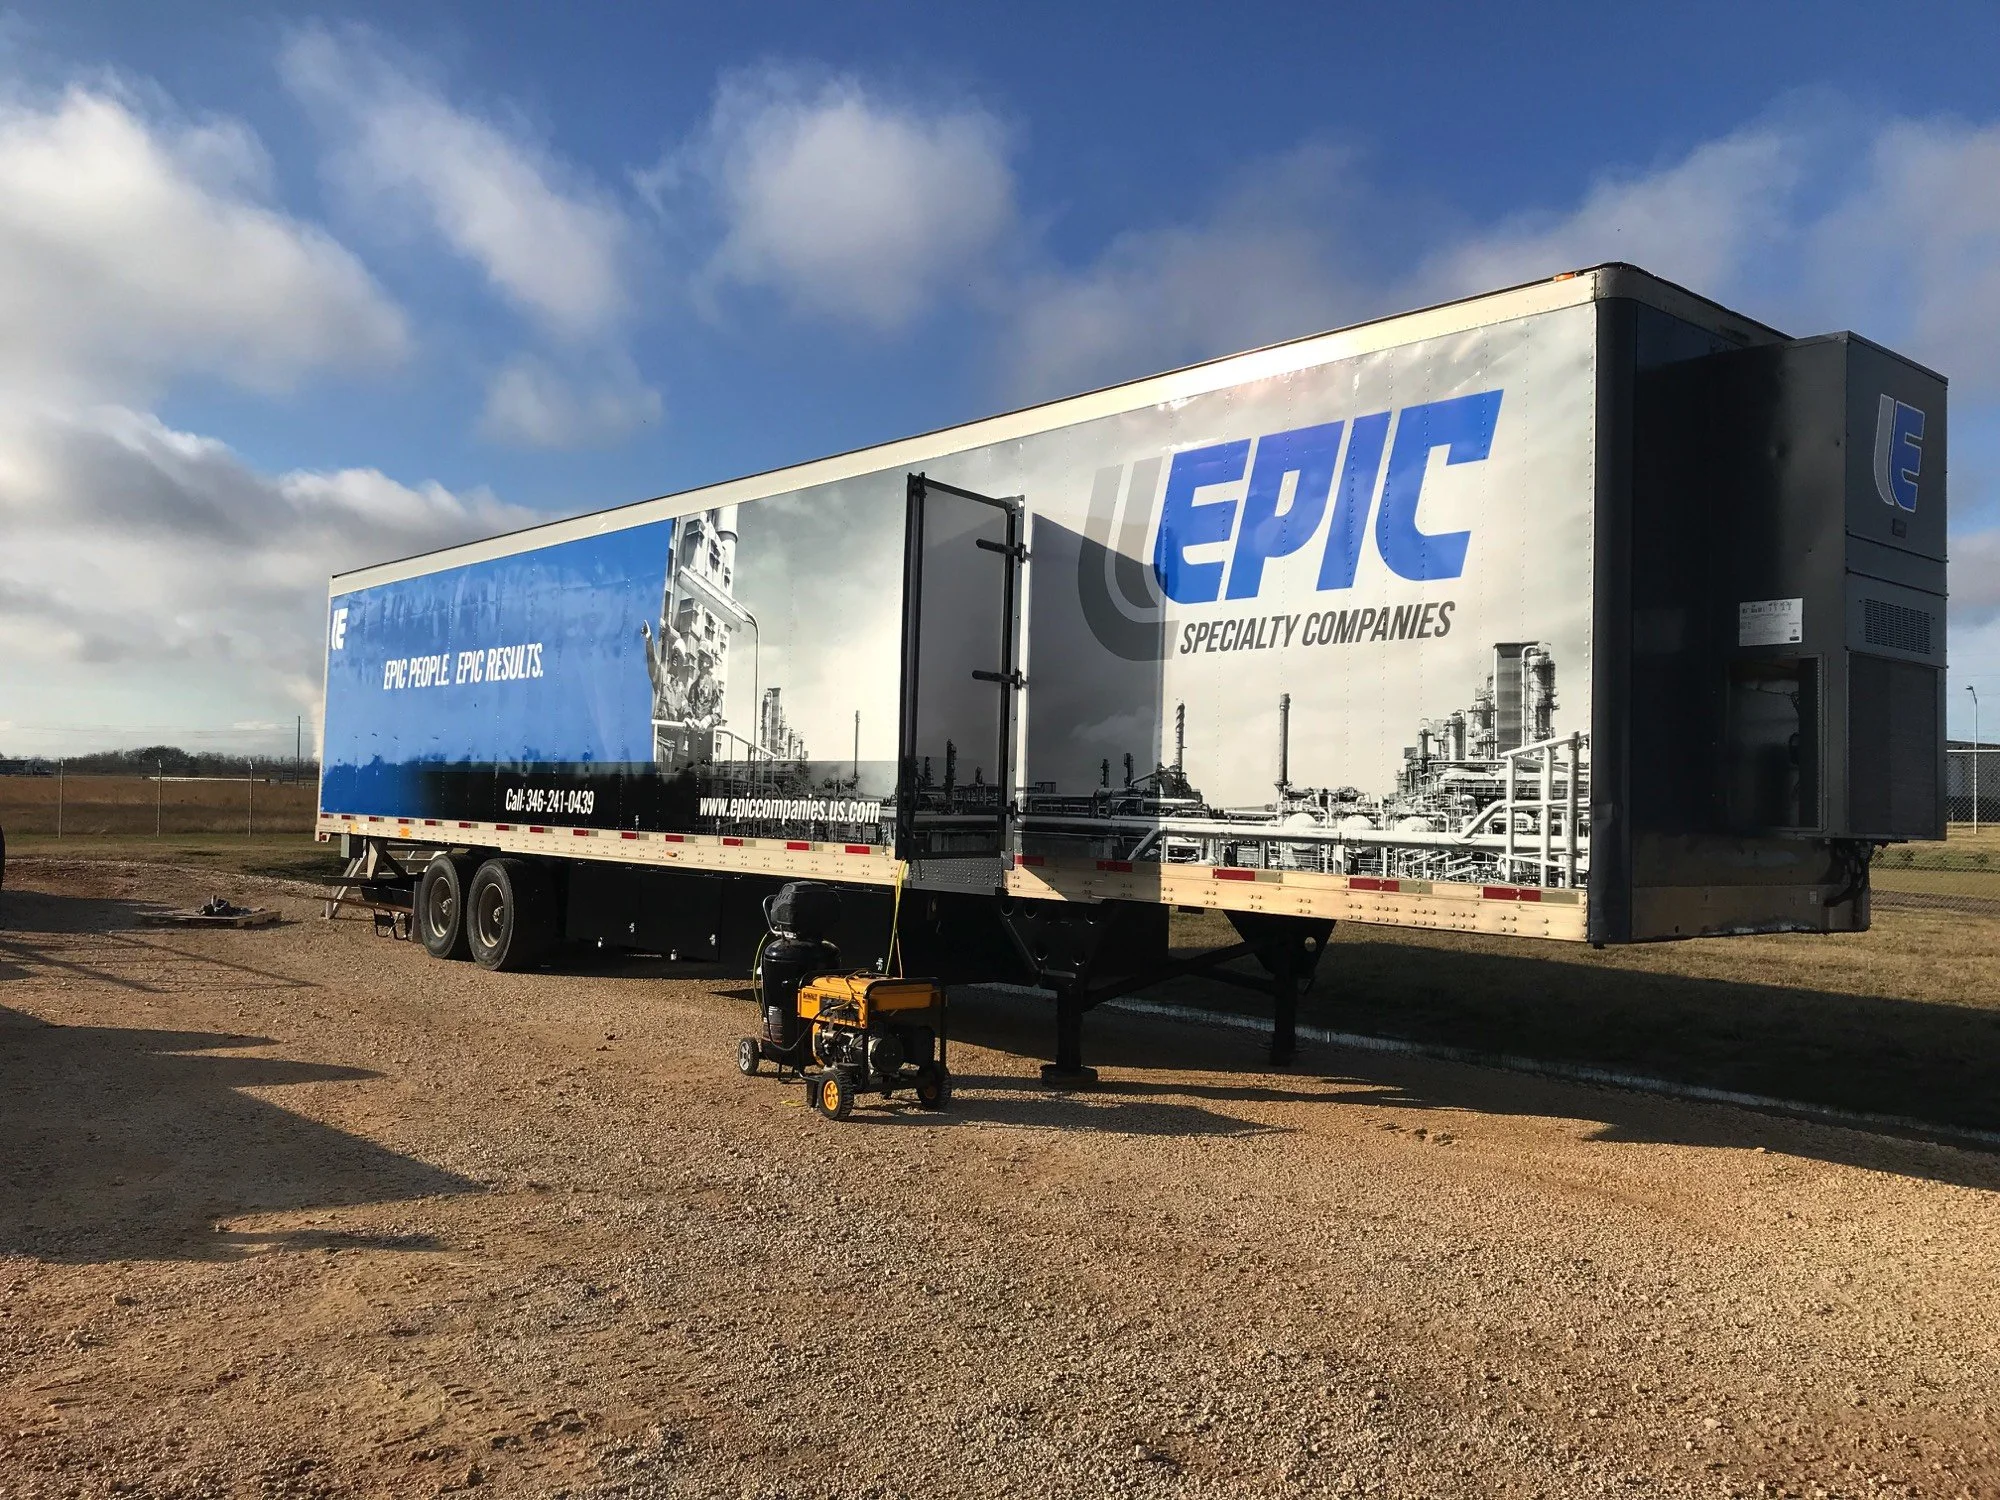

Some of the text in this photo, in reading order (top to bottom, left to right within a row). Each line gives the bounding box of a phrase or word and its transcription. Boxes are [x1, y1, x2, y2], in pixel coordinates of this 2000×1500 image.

[1153, 389, 1504, 604] EPIC
[1180, 600, 1456, 655] SPECIALTY COMPANIES
[383, 642, 544, 690] EPIC PEOPLE. EPIC RESULTS.
[505, 788, 594, 814] Call: 346-241-0439
[699, 792, 881, 825] www.epiccompanies.us.com
